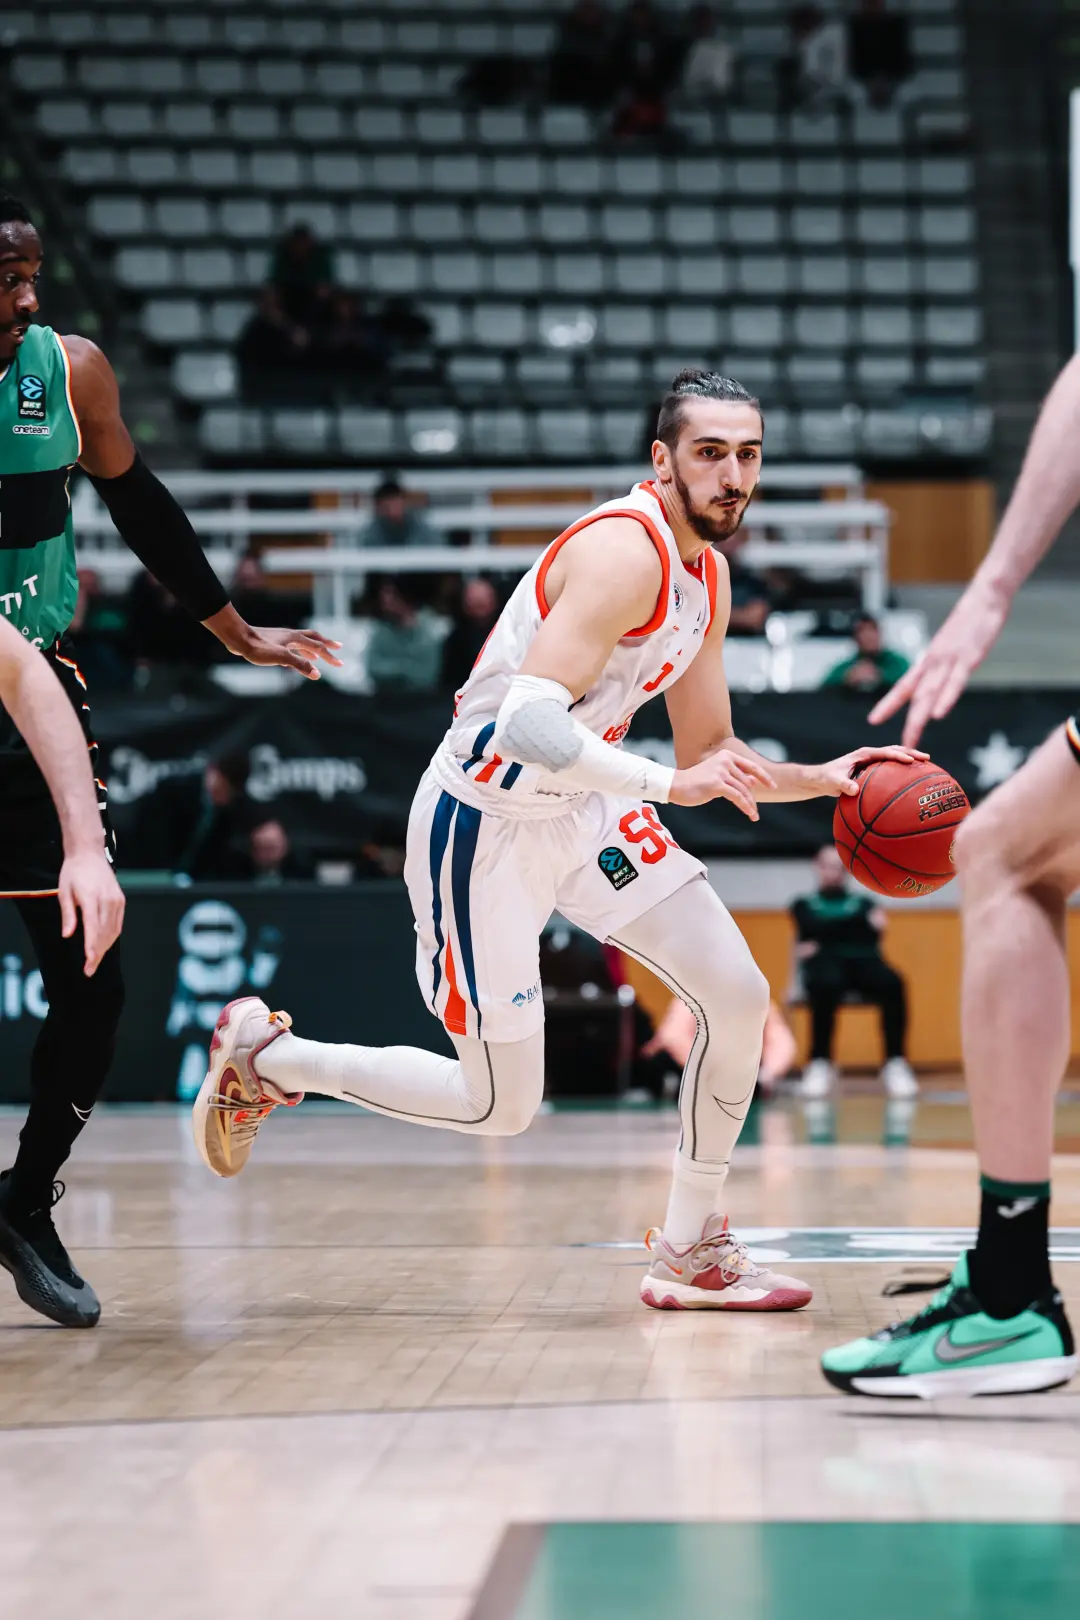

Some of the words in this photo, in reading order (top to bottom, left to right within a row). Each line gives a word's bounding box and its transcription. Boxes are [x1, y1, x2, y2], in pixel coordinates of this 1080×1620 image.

[20, 409, 44, 417] EuroCup
[13, 425, 50, 436] oneteam
[919, 795, 966, 824] EGACY
[612, 866, 629, 881] BKT
[614, 871, 637, 888] EuroCup
